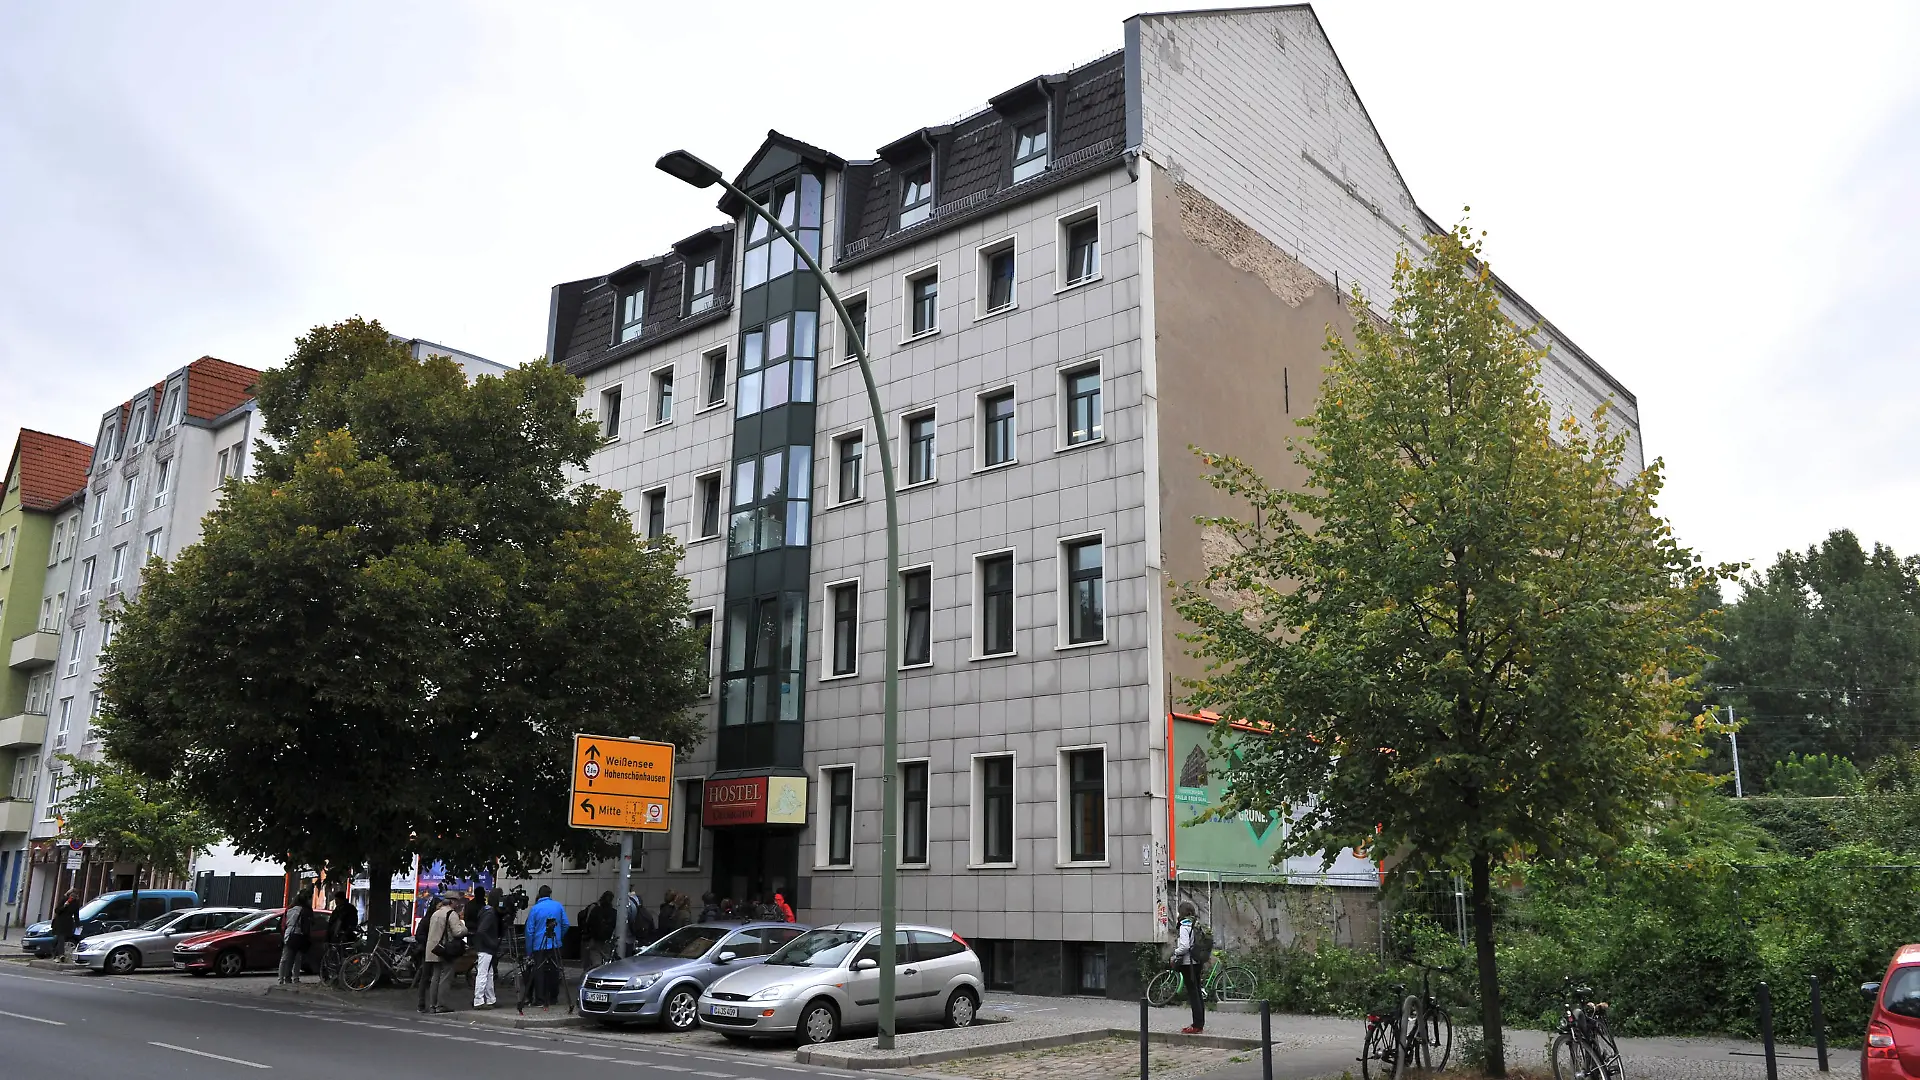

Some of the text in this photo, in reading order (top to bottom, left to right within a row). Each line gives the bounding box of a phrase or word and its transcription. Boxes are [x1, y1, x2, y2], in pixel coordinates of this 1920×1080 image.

[606, 756, 654, 769] Weißensee
[604, 769, 666, 783] Hohenschönhausen
[709, 784, 762, 802] HOSTEL
[599, 806, 621, 816] Mitte
